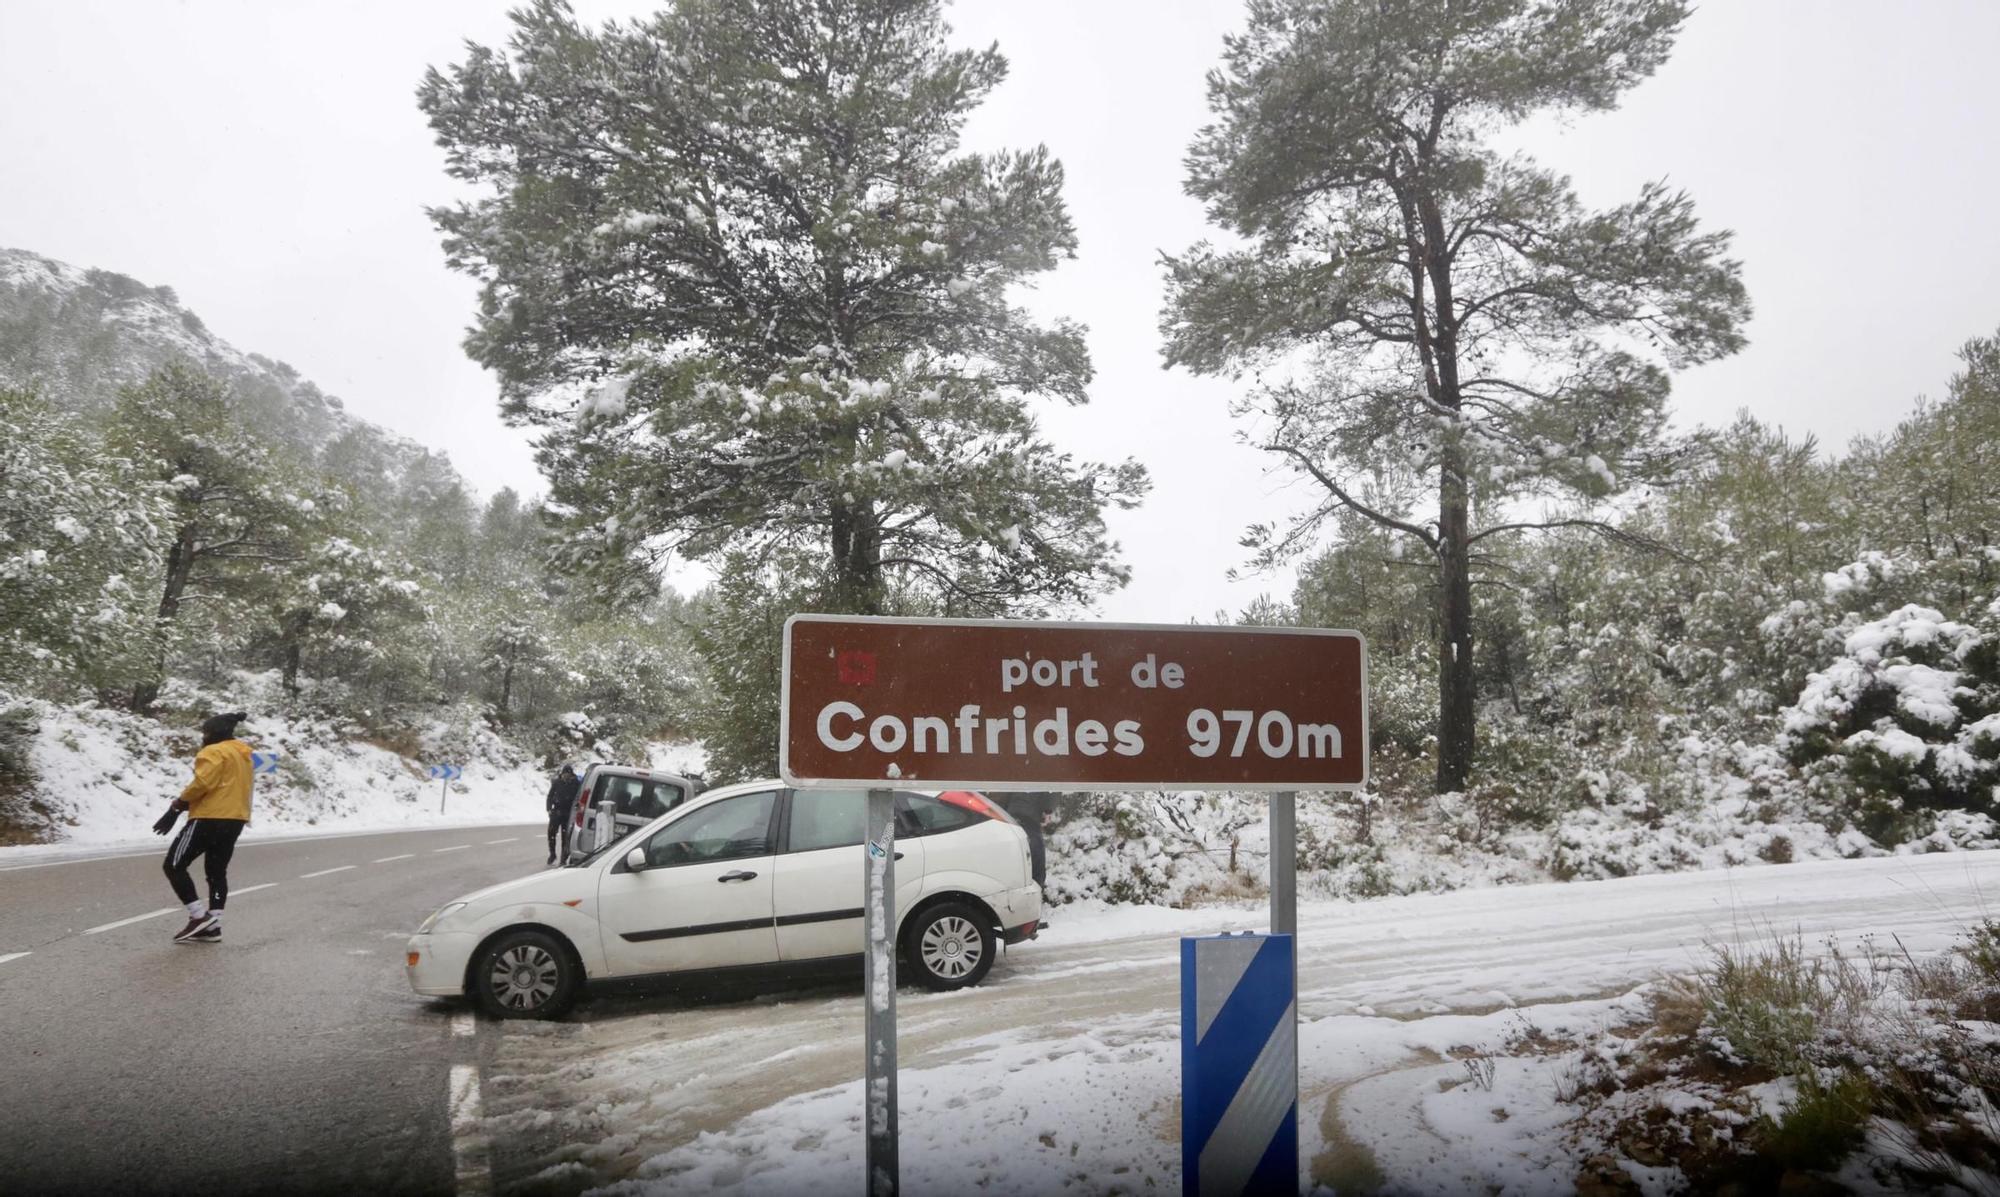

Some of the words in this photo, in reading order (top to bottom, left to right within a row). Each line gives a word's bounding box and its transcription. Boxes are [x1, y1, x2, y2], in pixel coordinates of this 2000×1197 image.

[1001, 652, 1099, 693] port
[1130, 653, 1185, 689] de
[816, 700, 1145, 757] Confrides
[1186, 708, 1342, 759] 970m
